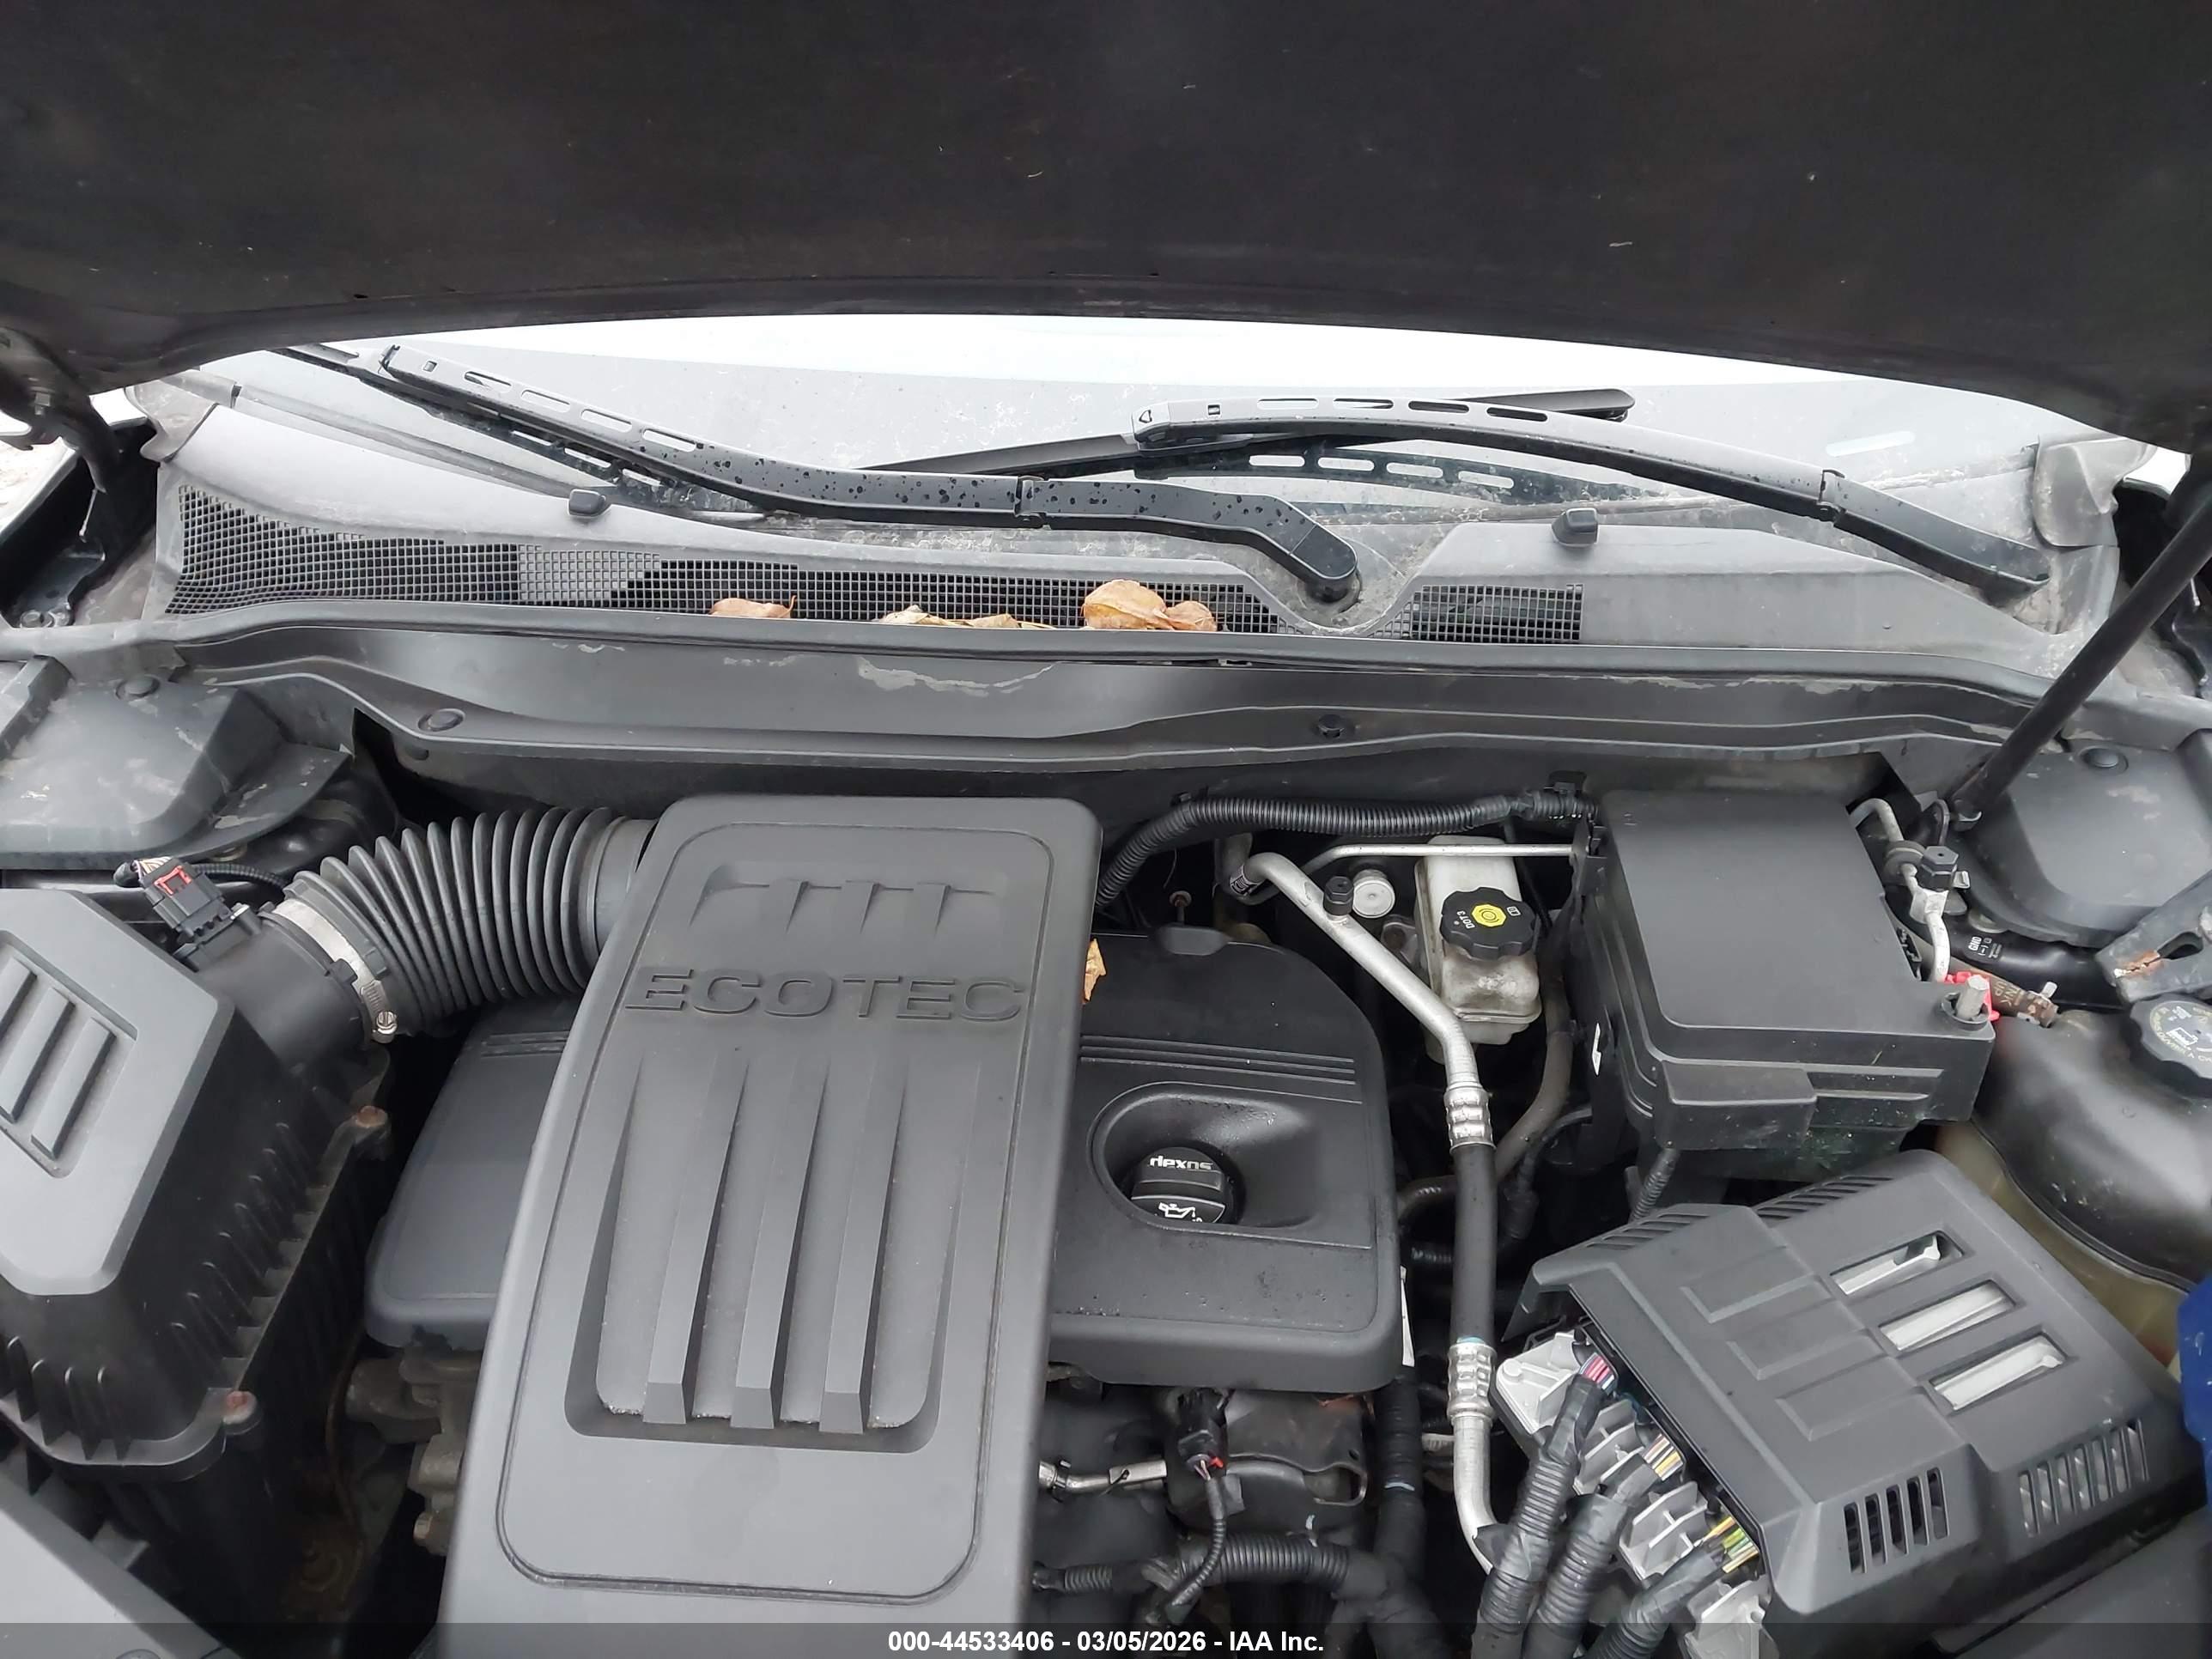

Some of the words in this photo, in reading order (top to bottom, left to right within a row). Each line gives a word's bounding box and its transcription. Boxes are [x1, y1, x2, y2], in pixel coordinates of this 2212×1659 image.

[1968, 936, 1982, 951] GND
[624, 968, 1025, 1022] ECOTEC
[1994, 981, 2008, 997] UP
[1150, 1156, 1213, 1170] dexos
